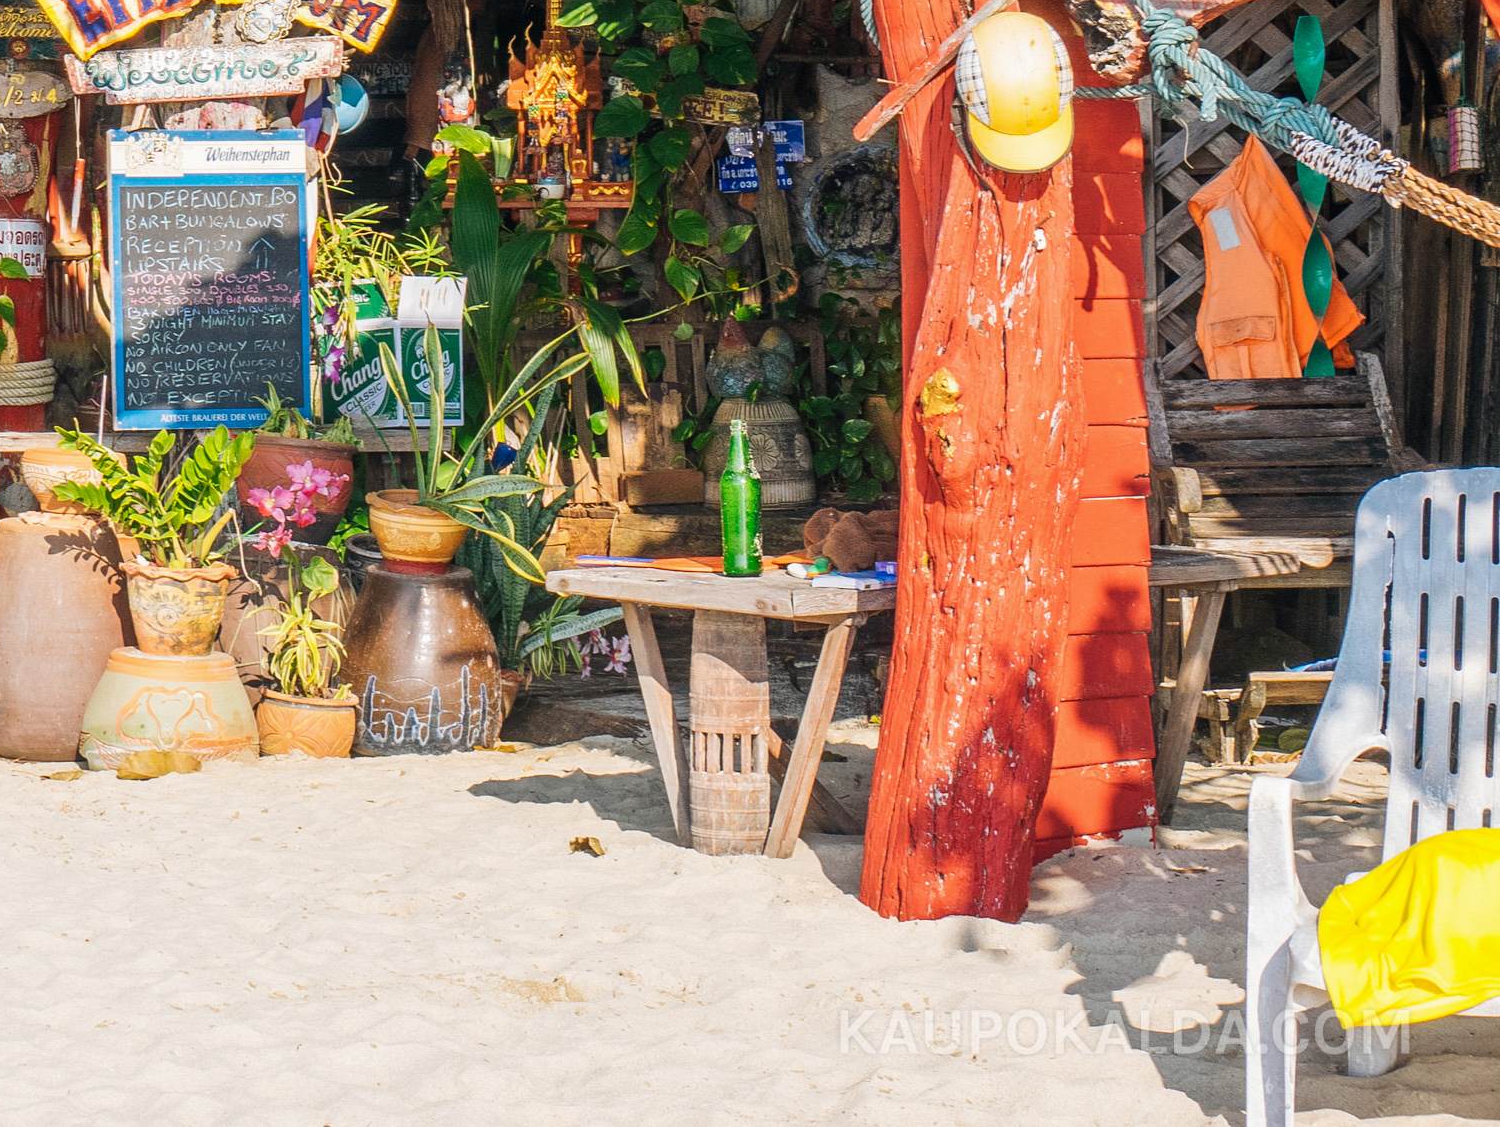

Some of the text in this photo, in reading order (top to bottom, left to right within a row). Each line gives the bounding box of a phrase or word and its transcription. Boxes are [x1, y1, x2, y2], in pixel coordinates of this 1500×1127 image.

[204, 146, 291, 164] Weihenstephan
[125, 187, 297, 210] INDEPENDENT BO
[175, 213, 286, 230] BUNGALOWS
[126, 236, 242, 255] RECEPTION
[128, 255, 225, 274] UPSTAIRS
[125, 270, 276, 286] TODAY'S ROOMS:
[127, 286, 174, 296] SINGLE
[127, 307, 158, 318] BAR
[148, 317, 195, 330] NIGHT
[201, 314, 255, 328] MINIMUM
[261, 313, 296, 325] STAY
[131, 330, 186, 345] SORRY
[125, 345, 145, 358] NO
[206, 340, 248, 353] ONLY
[254, 339, 286, 352] FAN
[125, 360, 147, 374] NO
[152, 358, 227, 373] CHILDREN
[411, 350, 451, 380] Chg
[127, 377, 150, 389] NO
[331, 356, 382, 401] Chang
[127, 389, 288, 406] NO EXCEPTI
[345, 382, 383, 413] CLASSIC
[192, 413, 229, 422] BRAUEREI
[230, 413, 246, 421] DER
[248, 412, 269, 421] WELT
